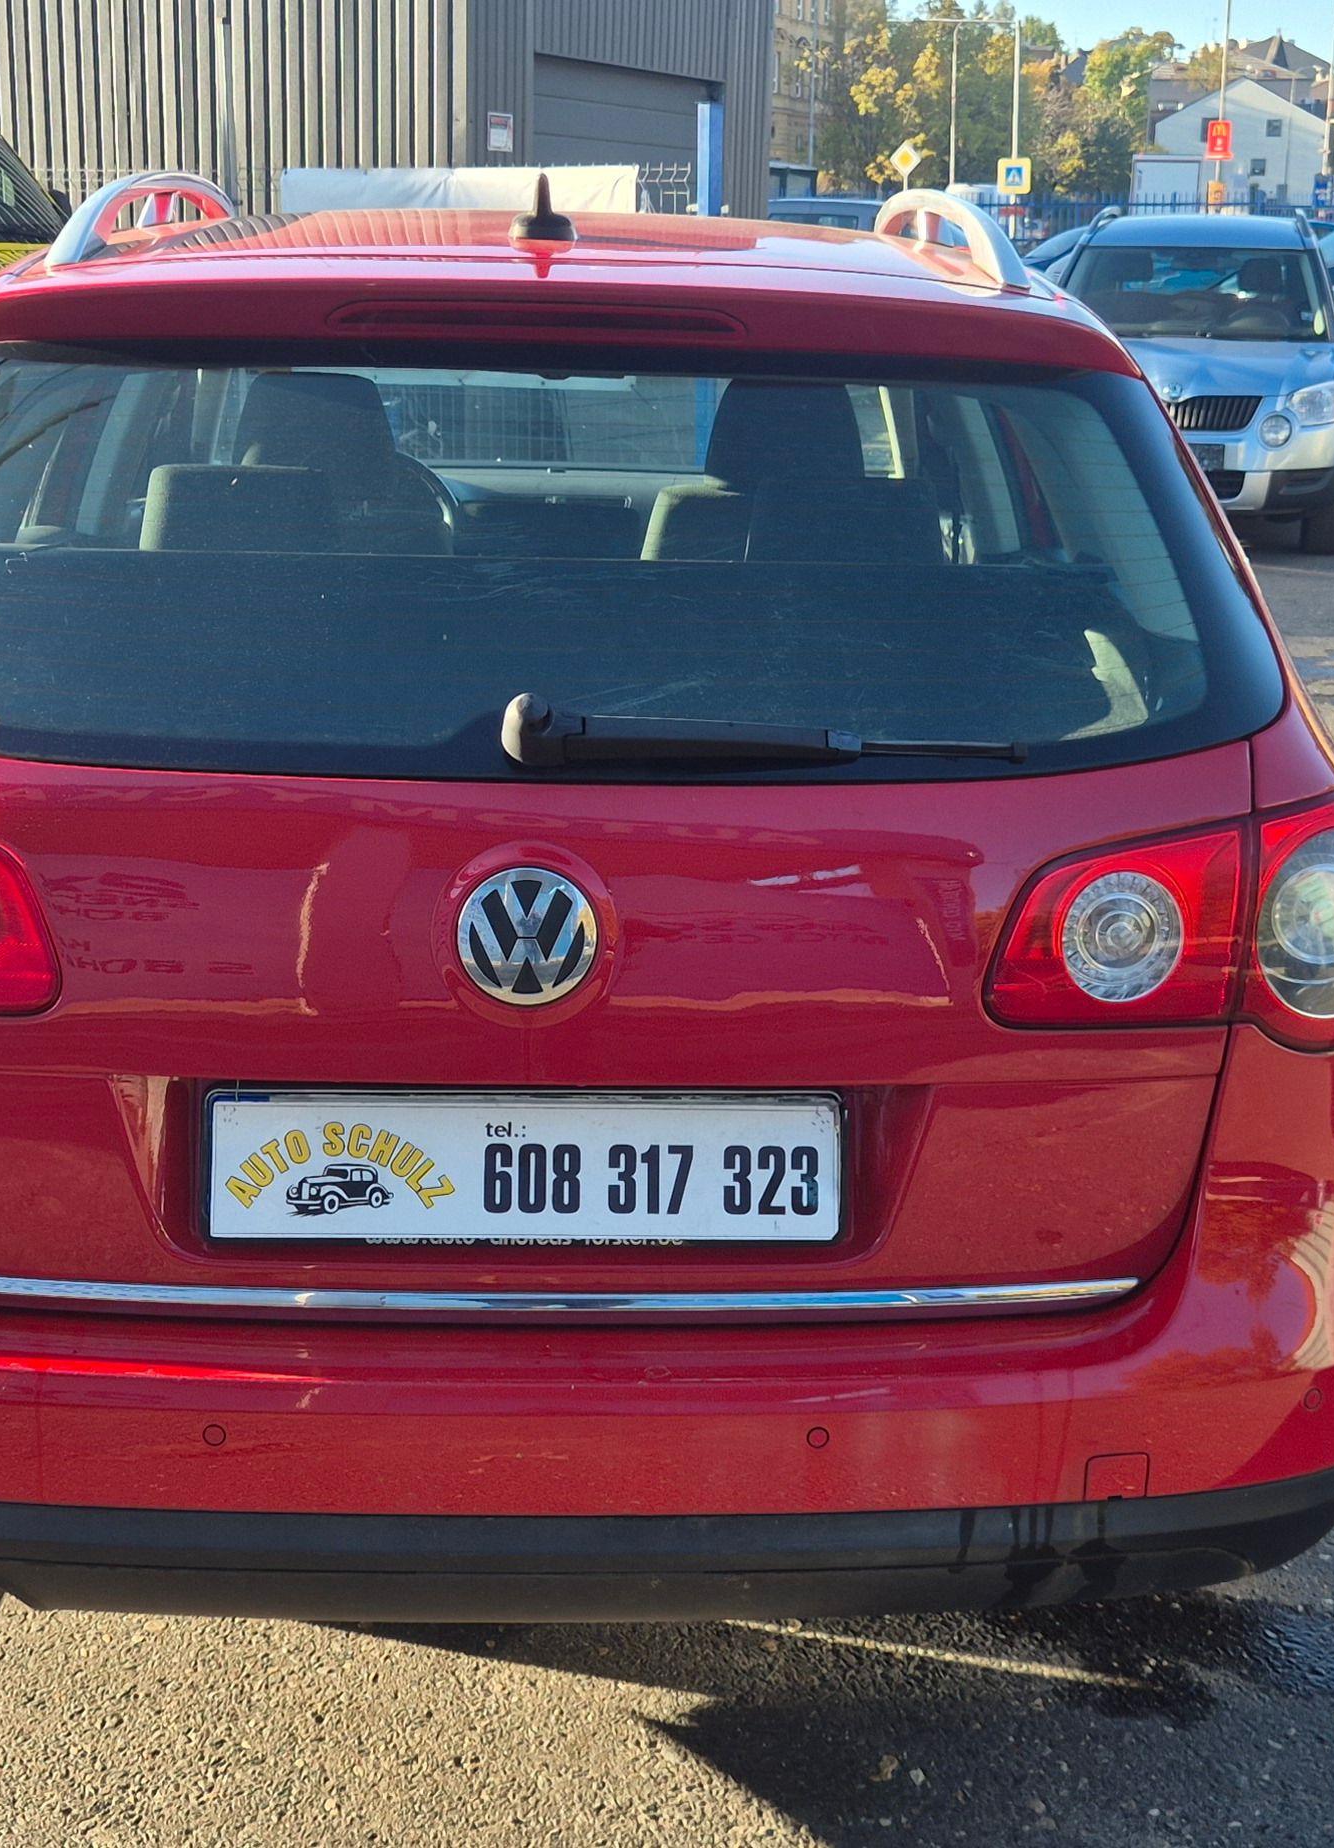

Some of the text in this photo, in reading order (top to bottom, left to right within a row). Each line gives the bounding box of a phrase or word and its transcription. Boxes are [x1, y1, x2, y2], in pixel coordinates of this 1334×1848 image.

[225, 1121, 456, 1209] AUTO SCHULZ
[485, 1121, 527, 1138] tel.:
[483, 1143, 819, 1216] 608 317 323
